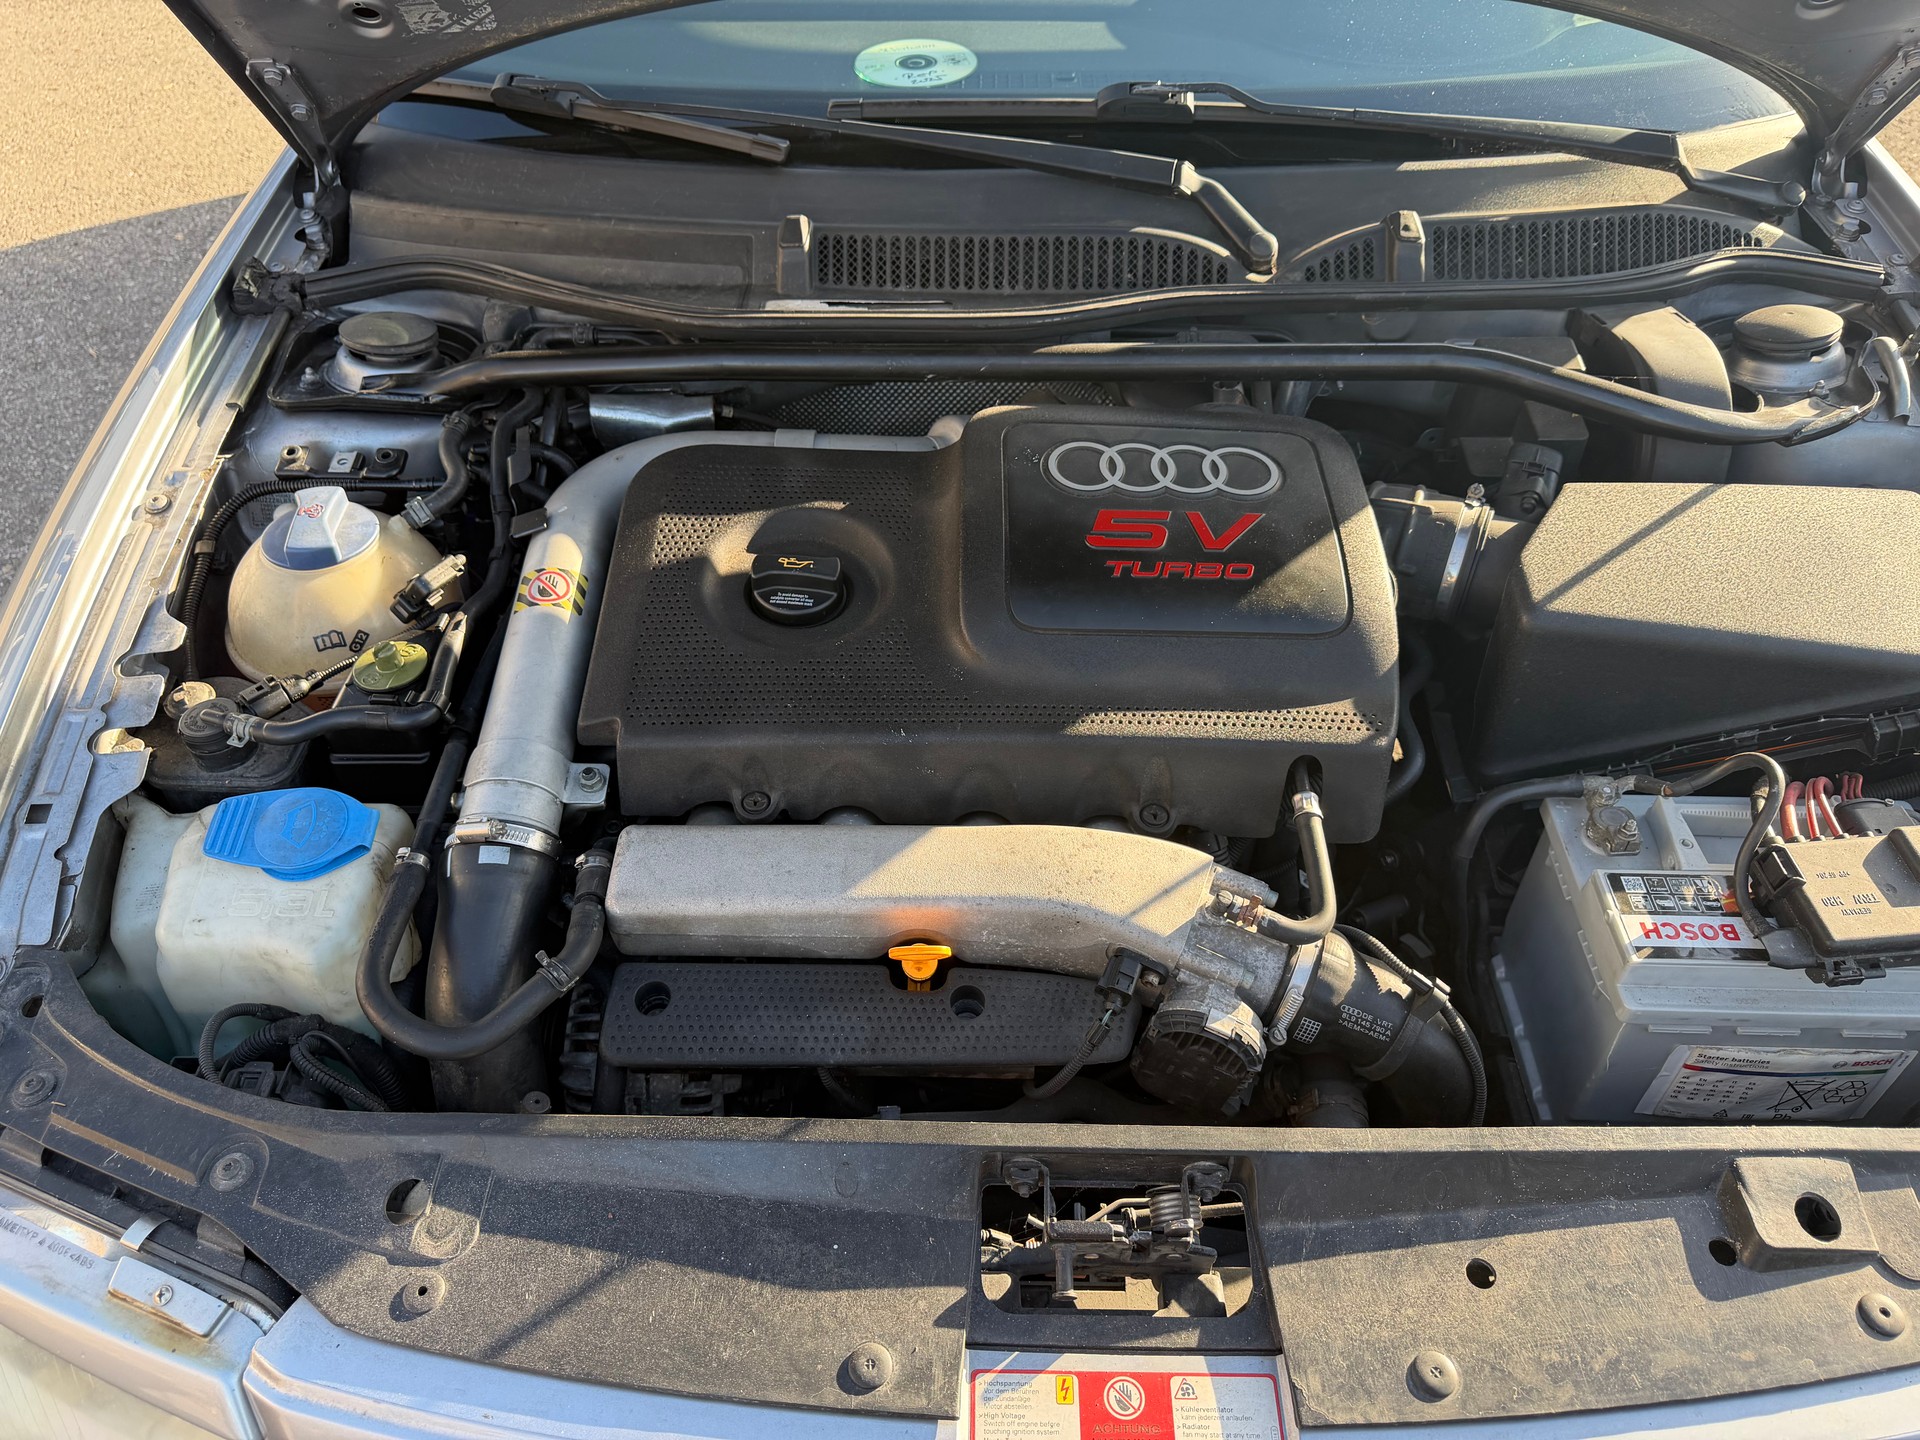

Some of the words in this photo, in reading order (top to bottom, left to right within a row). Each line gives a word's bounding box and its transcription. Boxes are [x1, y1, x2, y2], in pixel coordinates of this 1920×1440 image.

[1104, 560, 1254, 580] TURBO
[351, 632, 368, 651] G12
[1640, 922, 1741, 941] BOSCH
[1341, 1012, 1356, 1022] 8L9
[1358, 1018, 1370, 1028] 145
[1371, 1024, 1385, 1034] 790
[1697, 1053, 1729, 1061] Starter
[1694, 1058, 1720, 1066] Safety
[1721, 1061, 1770, 1070] instructions
[1851, 1058, 1894, 1067] BOSCH
[984, 1380, 1033, 1389] Hochspannung
[984, 1412, 999, 1420] High
[1001, 1412, 1026, 1420] Voltage
[1040, 1420, 1061, 1428] before
[984, 1429, 1011, 1437] touching
[1012, 1428, 1035, 1437] ignition
[1093, 1424, 1161, 1434] ACHTUNG
